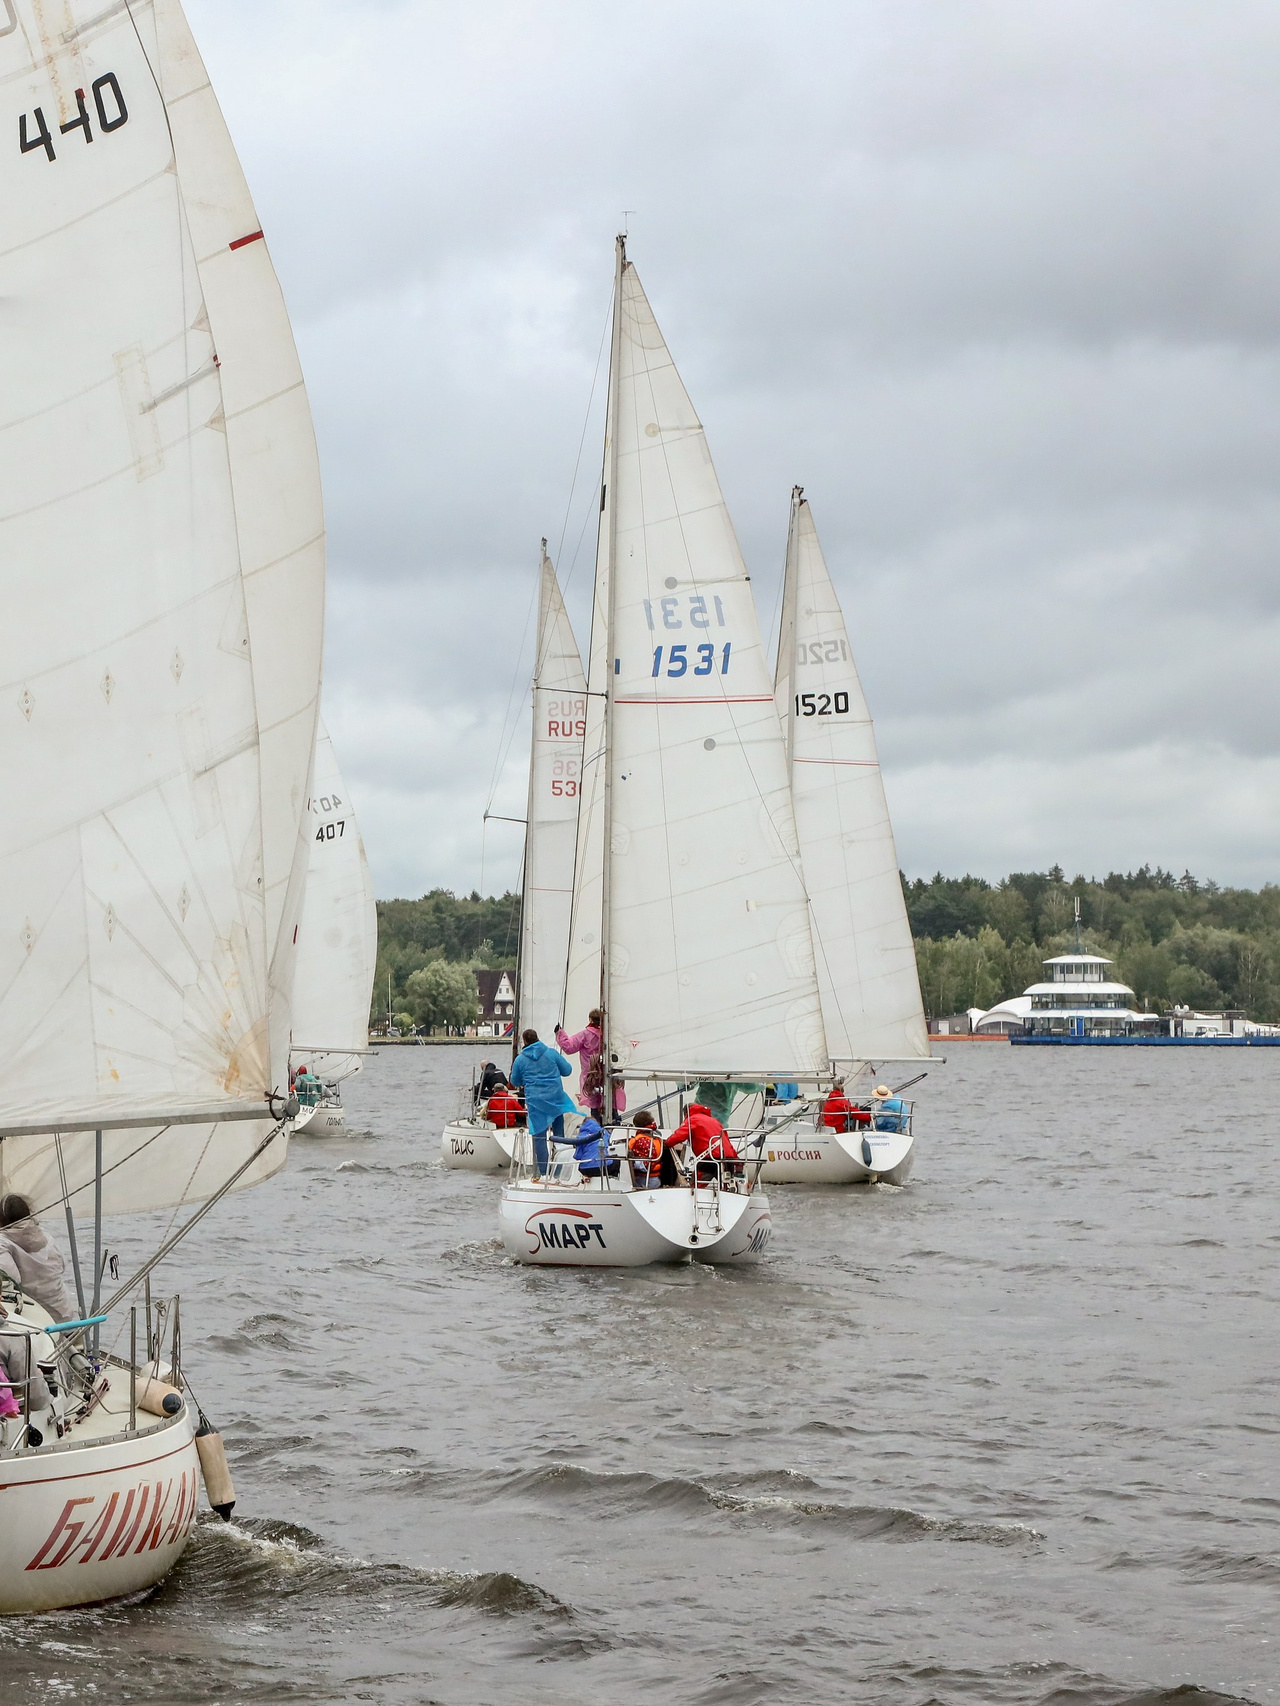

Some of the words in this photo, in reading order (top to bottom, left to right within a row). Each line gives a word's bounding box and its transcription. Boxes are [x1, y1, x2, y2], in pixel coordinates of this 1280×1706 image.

[19, 71, 129, 162] 440
[651, 642, 732, 678] 1531
[795, 691, 849, 717] 1520
[548, 720, 586, 738] RUS
[551, 780, 582, 797] 53
[315, 820, 346, 843] 407
[776, 1149, 822, 1161] РОССИЯ
